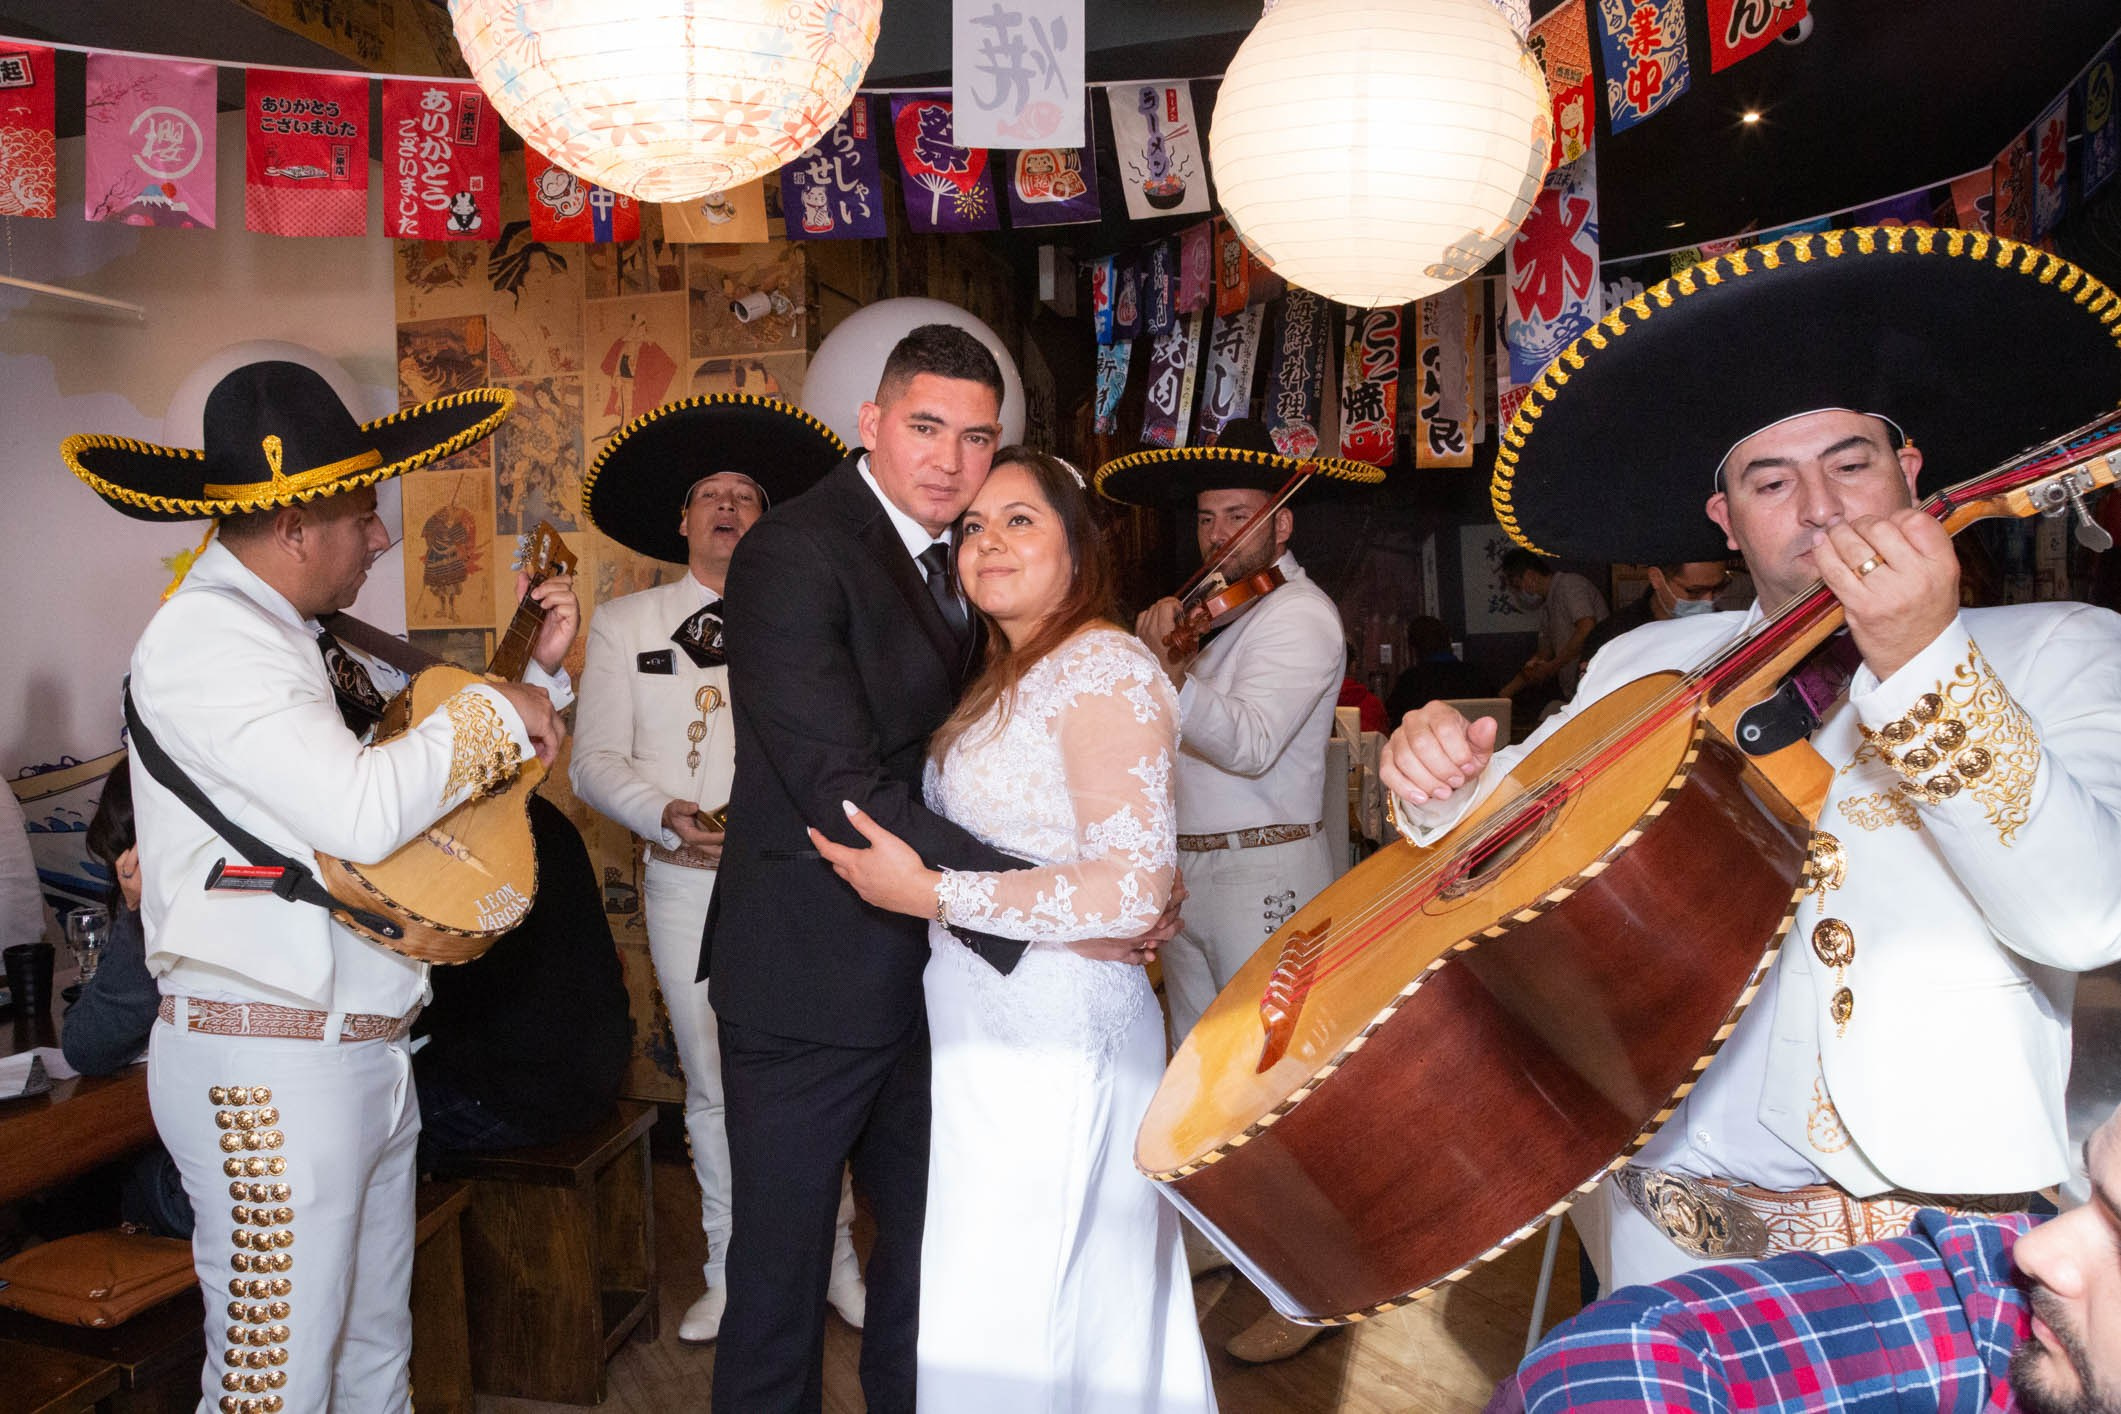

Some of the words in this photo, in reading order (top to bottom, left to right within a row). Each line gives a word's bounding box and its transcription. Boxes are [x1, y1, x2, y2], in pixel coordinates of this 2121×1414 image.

[1629, 0, 1662, 114] 業中
[259, 116, 358, 138] ございました
[261, 97, 340, 116] ありがとう
[420, 88, 453, 211] ありがとう
[460, 96, 474, 142] ご来店
[1142, 91, 1169, 178] ラーメン
[398, 118, 419, 236] ございました
[832, 108, 872, 225] らっしゃい
[1511, 188, 1595, 324] 氷
[1148, 320, 1189, 416] 焼肉
[1276, 288, 1318, 422] 海鮮料理
[474, 883, 517, 915] LEON
[476, 892, 530, 931] VARGAS
